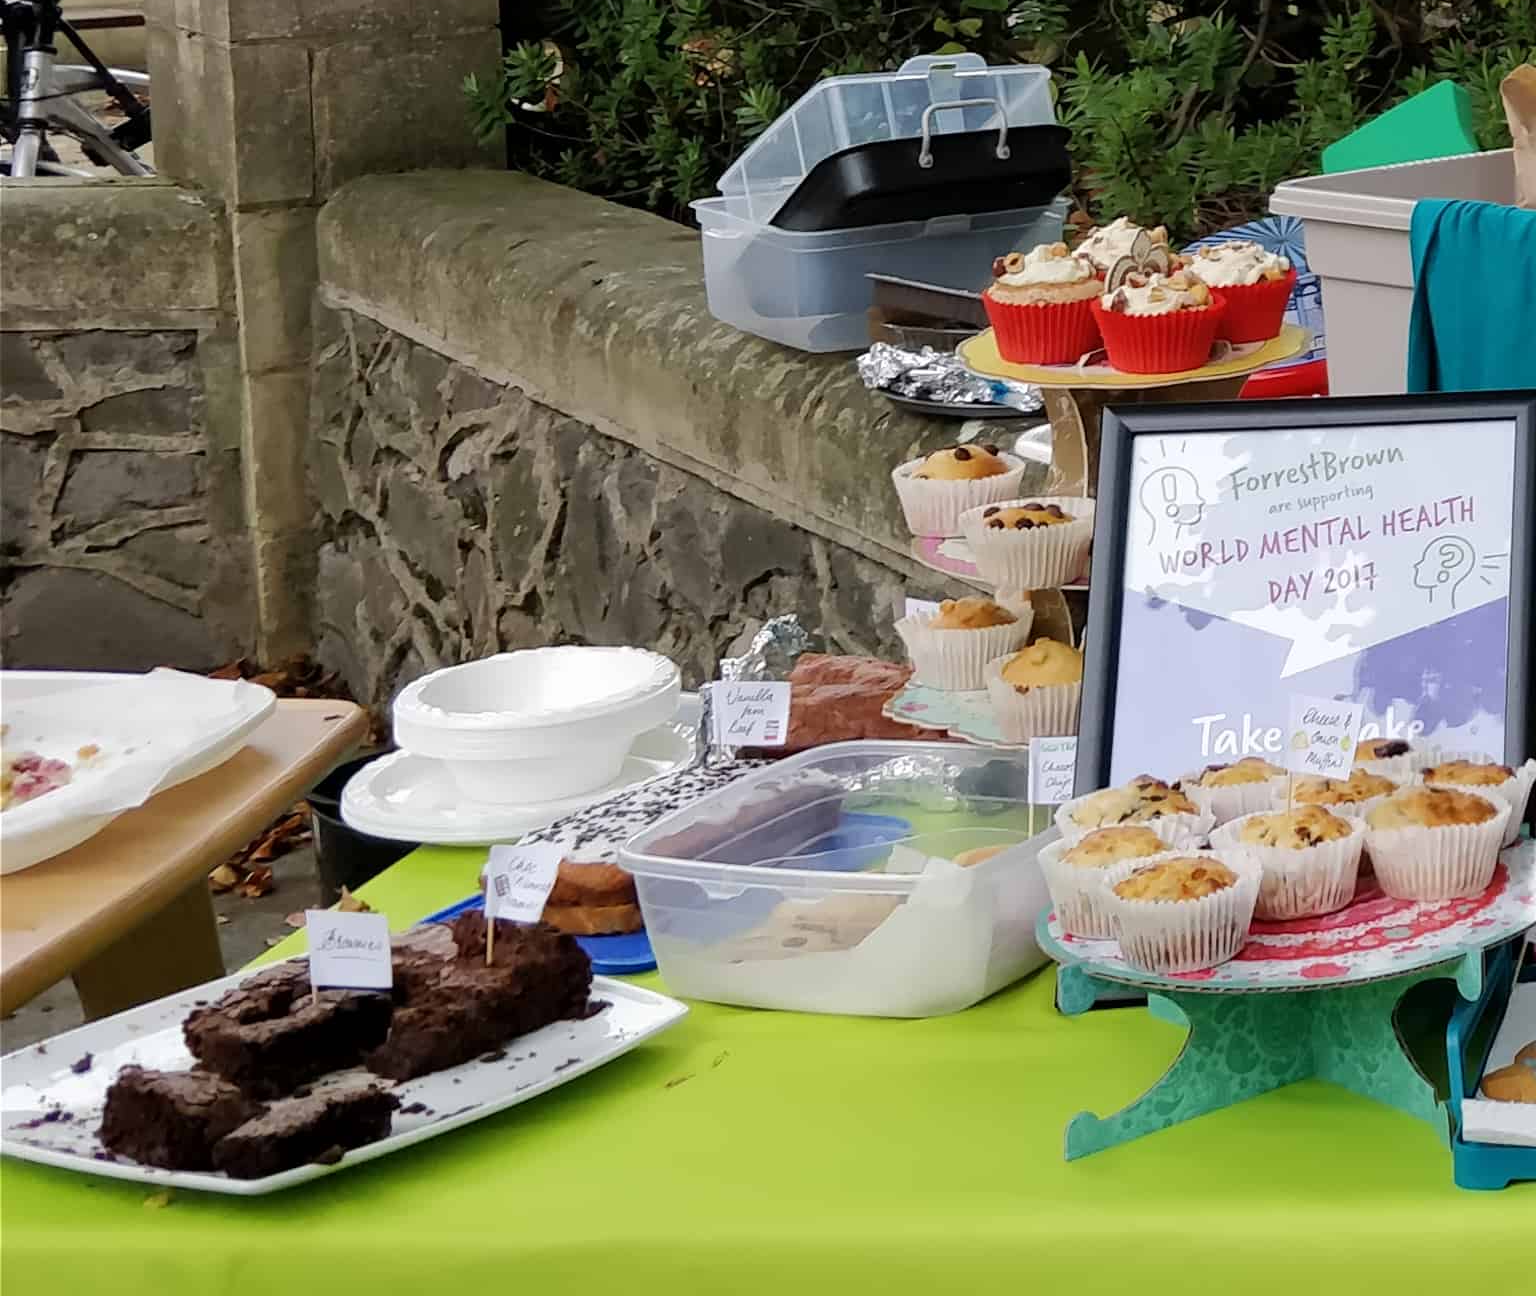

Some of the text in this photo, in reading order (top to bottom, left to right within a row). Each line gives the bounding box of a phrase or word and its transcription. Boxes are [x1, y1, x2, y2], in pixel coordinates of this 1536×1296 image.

[1229, 446, 1405, 500] ForrestBrown
[1268, 483, 1374, 515] are supporting
[1159, 496, 1475, 575] WORLD MENTAL HEALTH
[1268, 562, 1379, 604] DAY 2017
[727, 687, 774, 705] Vanilla
[1191, 713, 1283, 757] Take
